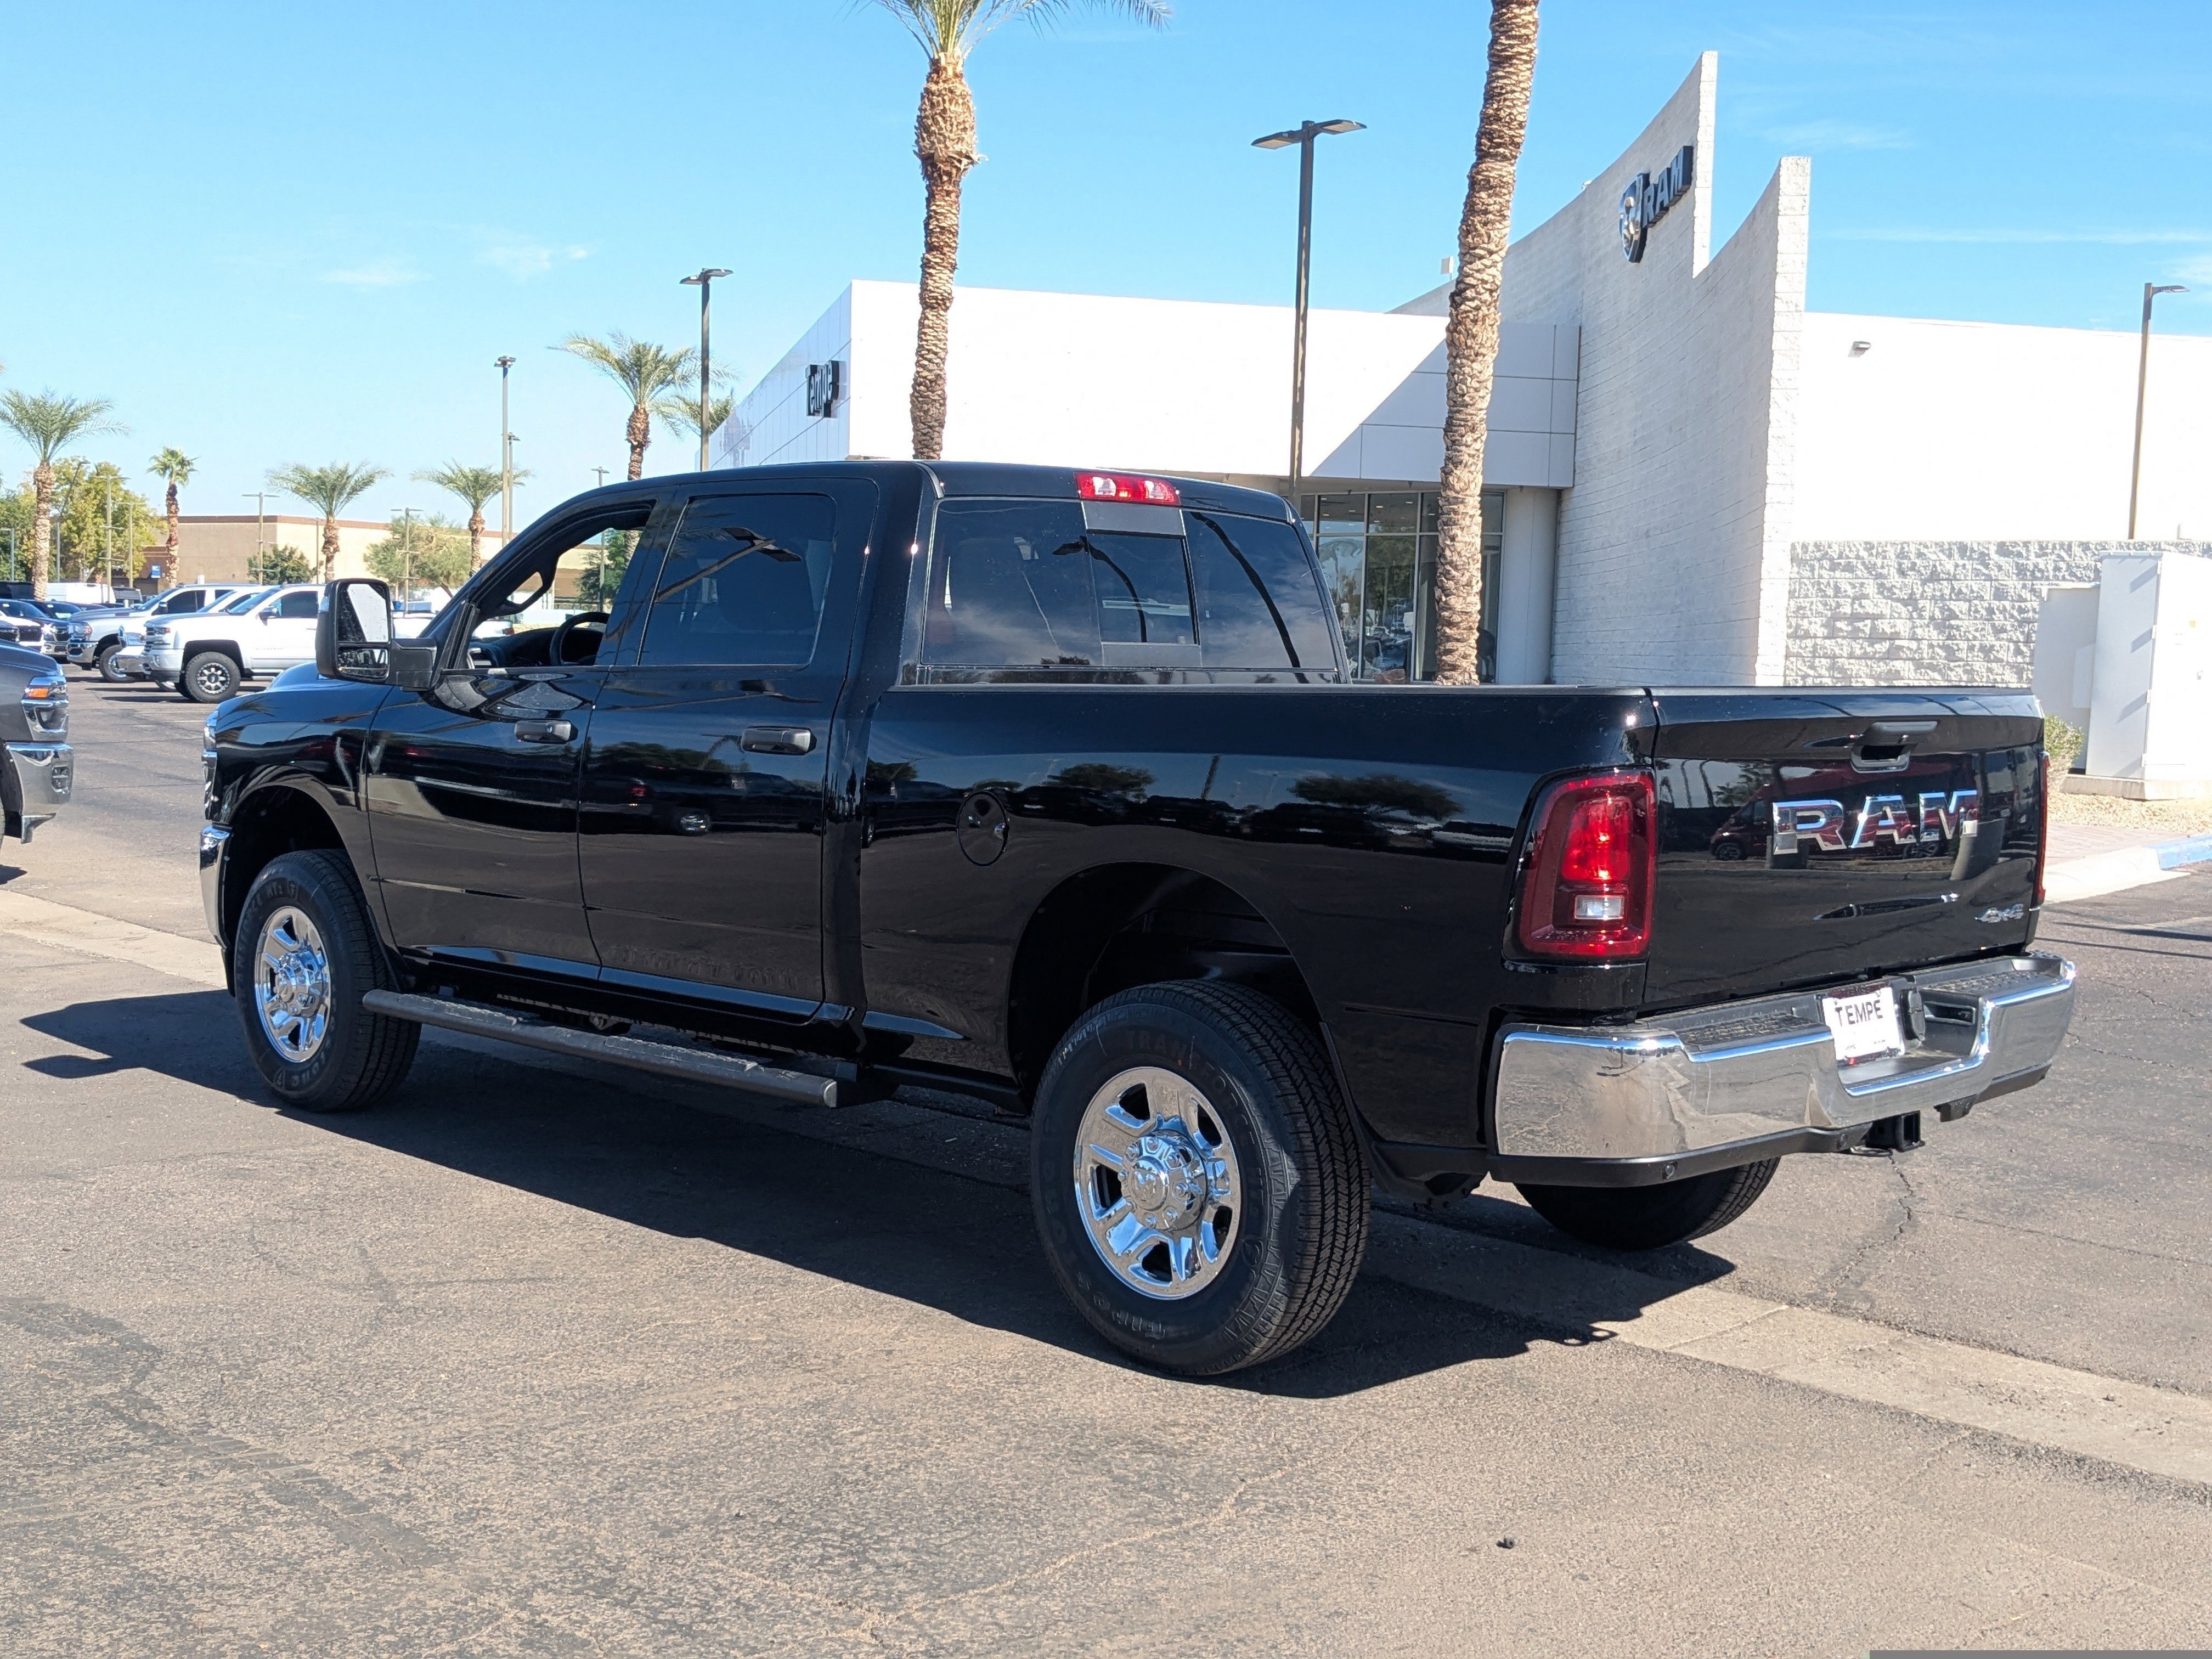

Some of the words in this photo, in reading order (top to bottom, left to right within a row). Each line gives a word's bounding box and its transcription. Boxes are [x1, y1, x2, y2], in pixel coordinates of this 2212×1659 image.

[1642, 146, 1694, 228] RAM
[1773, 789, 1978, 855] RAM
[1835, 999, 1883, 1026] TEMPE
